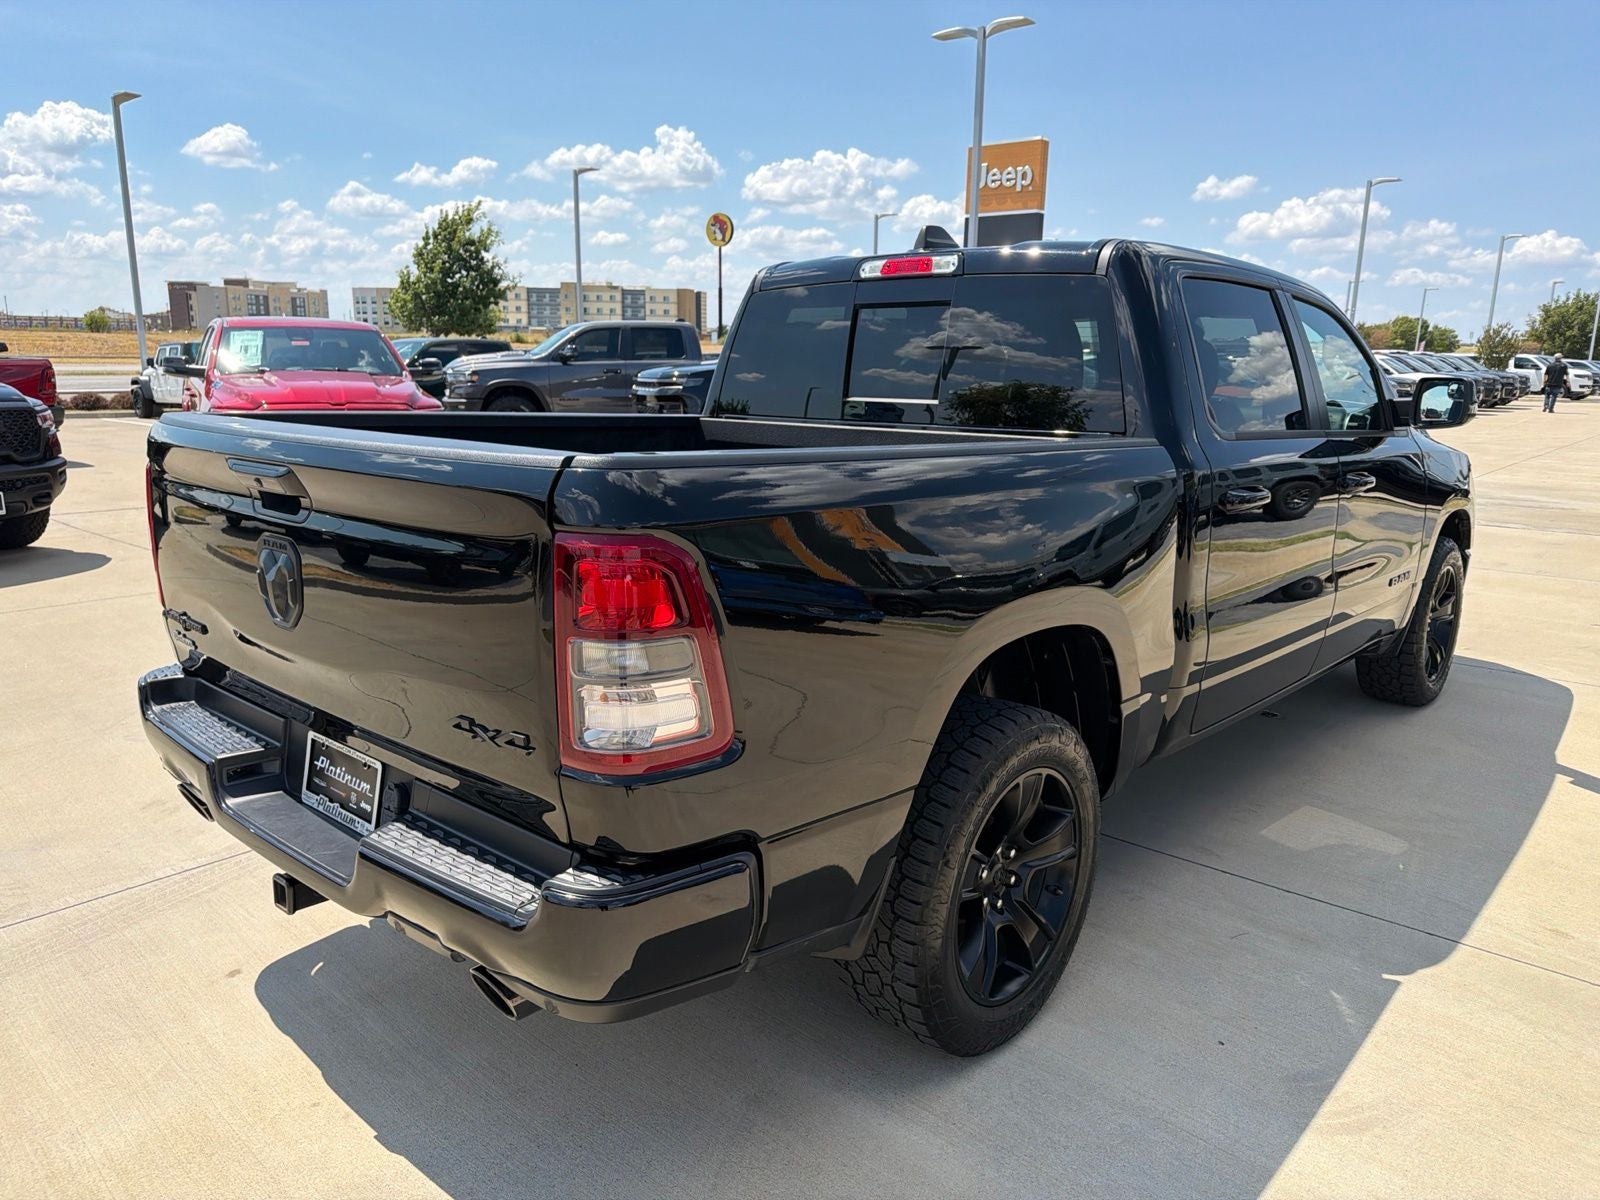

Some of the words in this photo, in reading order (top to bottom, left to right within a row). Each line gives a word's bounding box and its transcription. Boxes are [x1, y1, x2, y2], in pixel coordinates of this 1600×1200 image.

[979, 162, 1033, 192] Jeep
[1388, 570, 1411, 587] RAM
[314, 756, 373, 797] Platinum
[316, 797, 360, 829] Platinum
